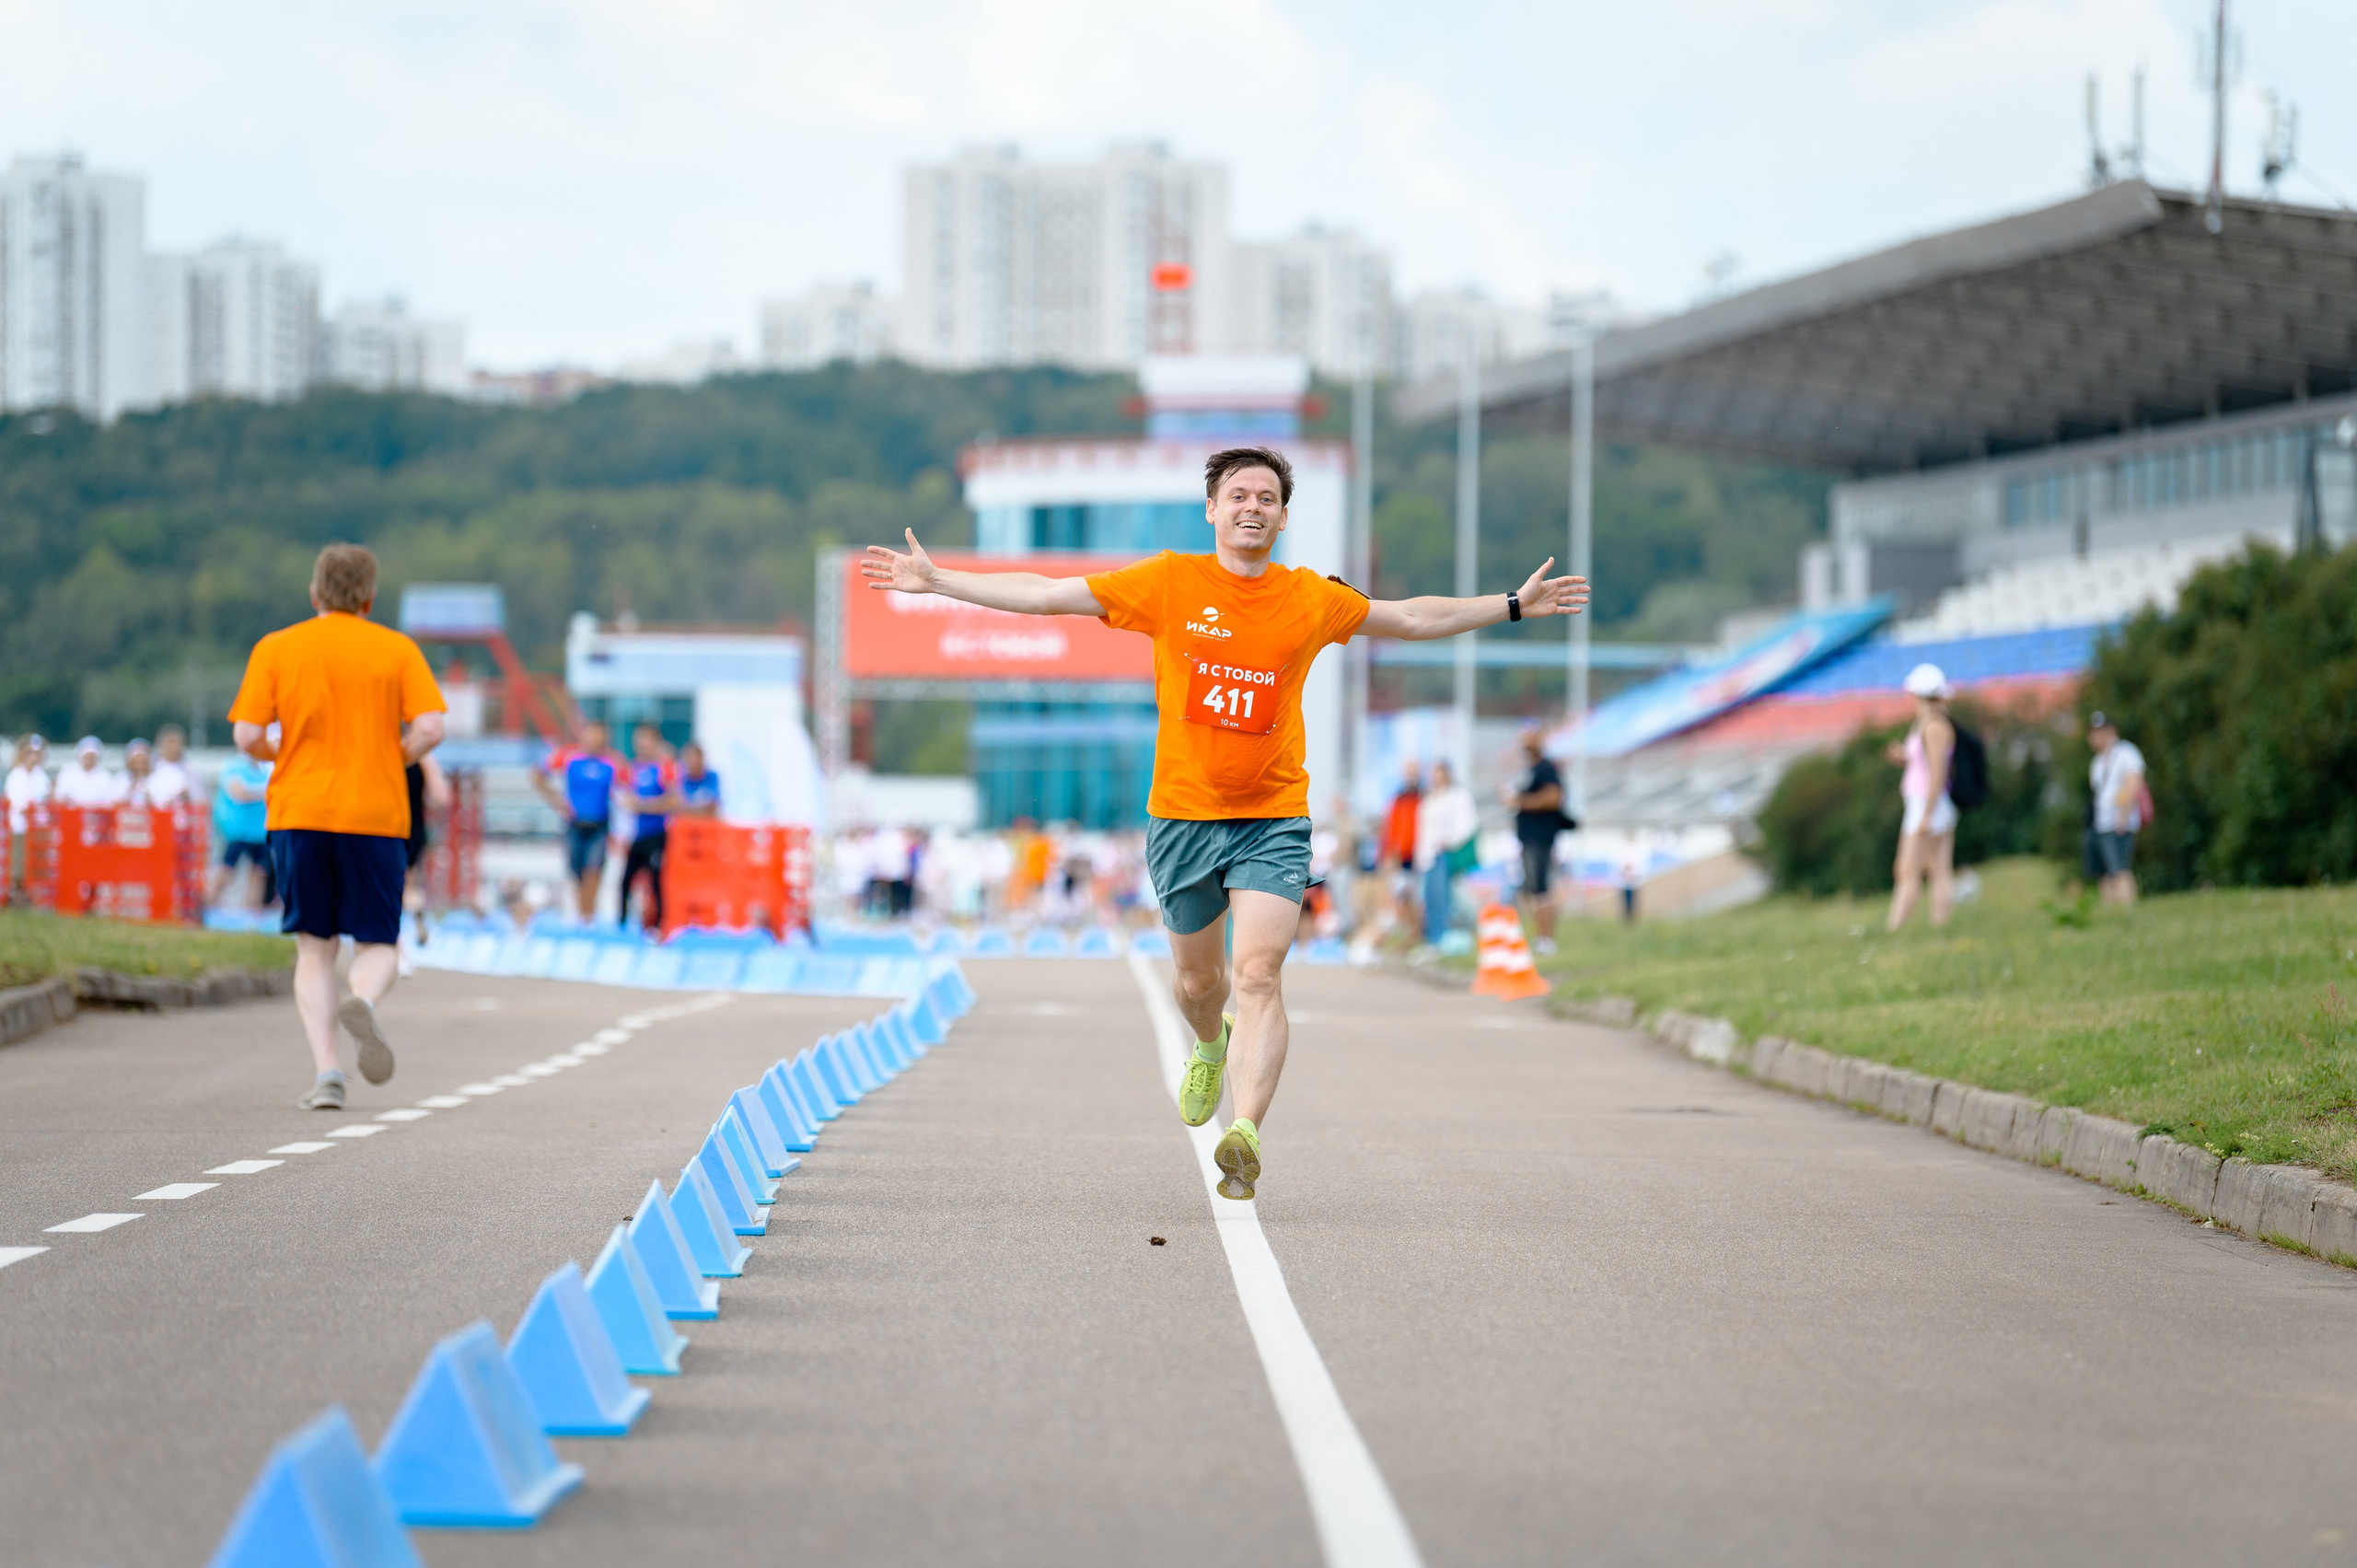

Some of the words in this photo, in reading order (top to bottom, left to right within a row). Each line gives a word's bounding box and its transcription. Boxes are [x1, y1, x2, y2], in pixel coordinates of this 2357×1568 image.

[1186, 621, 1232, 638] ИКАР
[1198, 662, 1208, 675] Я
[1211, 665, 1221, 677] С
[1224, 666, 1275, 687] ТОБОЙ
[1202, 684, 1254, 718] 411
[1221, 718, 1228, 726] 10
